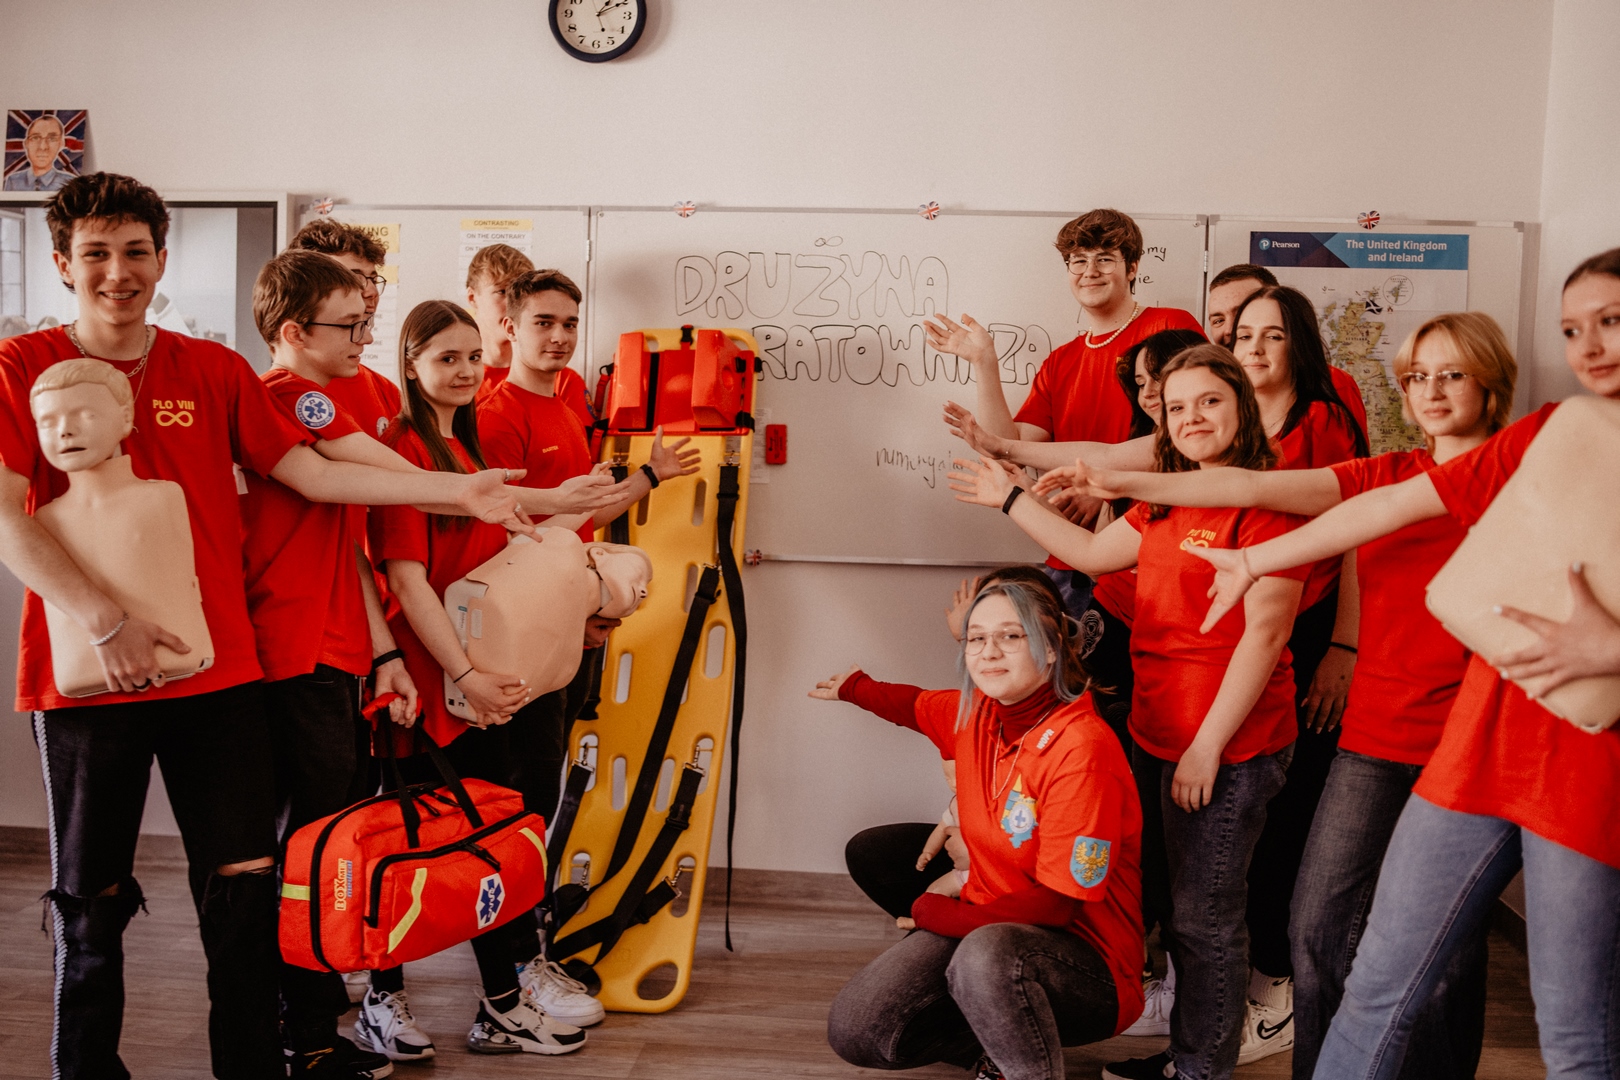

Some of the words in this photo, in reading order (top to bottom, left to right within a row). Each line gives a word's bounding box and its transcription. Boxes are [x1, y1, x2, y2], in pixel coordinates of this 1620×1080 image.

[564, 9, 573, 18] 9
[623, 11, 632, 20] 3
[568, 24, 577, 33] 8
[578, 35, 586, 44] 7
[606, 36, 615, 45] 5
[592, 40, 600, 49] 6
[1346, 240, 1364, 248] The
[1367, 240, 1400, 249] United
[1403, 241, 1447, 252] Kingdom
[1368, 253, 1386, 262] and
[1389, 253, 1424, 262] Ireland
[752, 323, 1052, 386] RATOWNZA
[153, 399, 173, 410] PLO
[176, 400, 195, 410] VIII
[1201, 529, 1217, 541] VIII
[1036, 729, 1055, 749] WOPR
